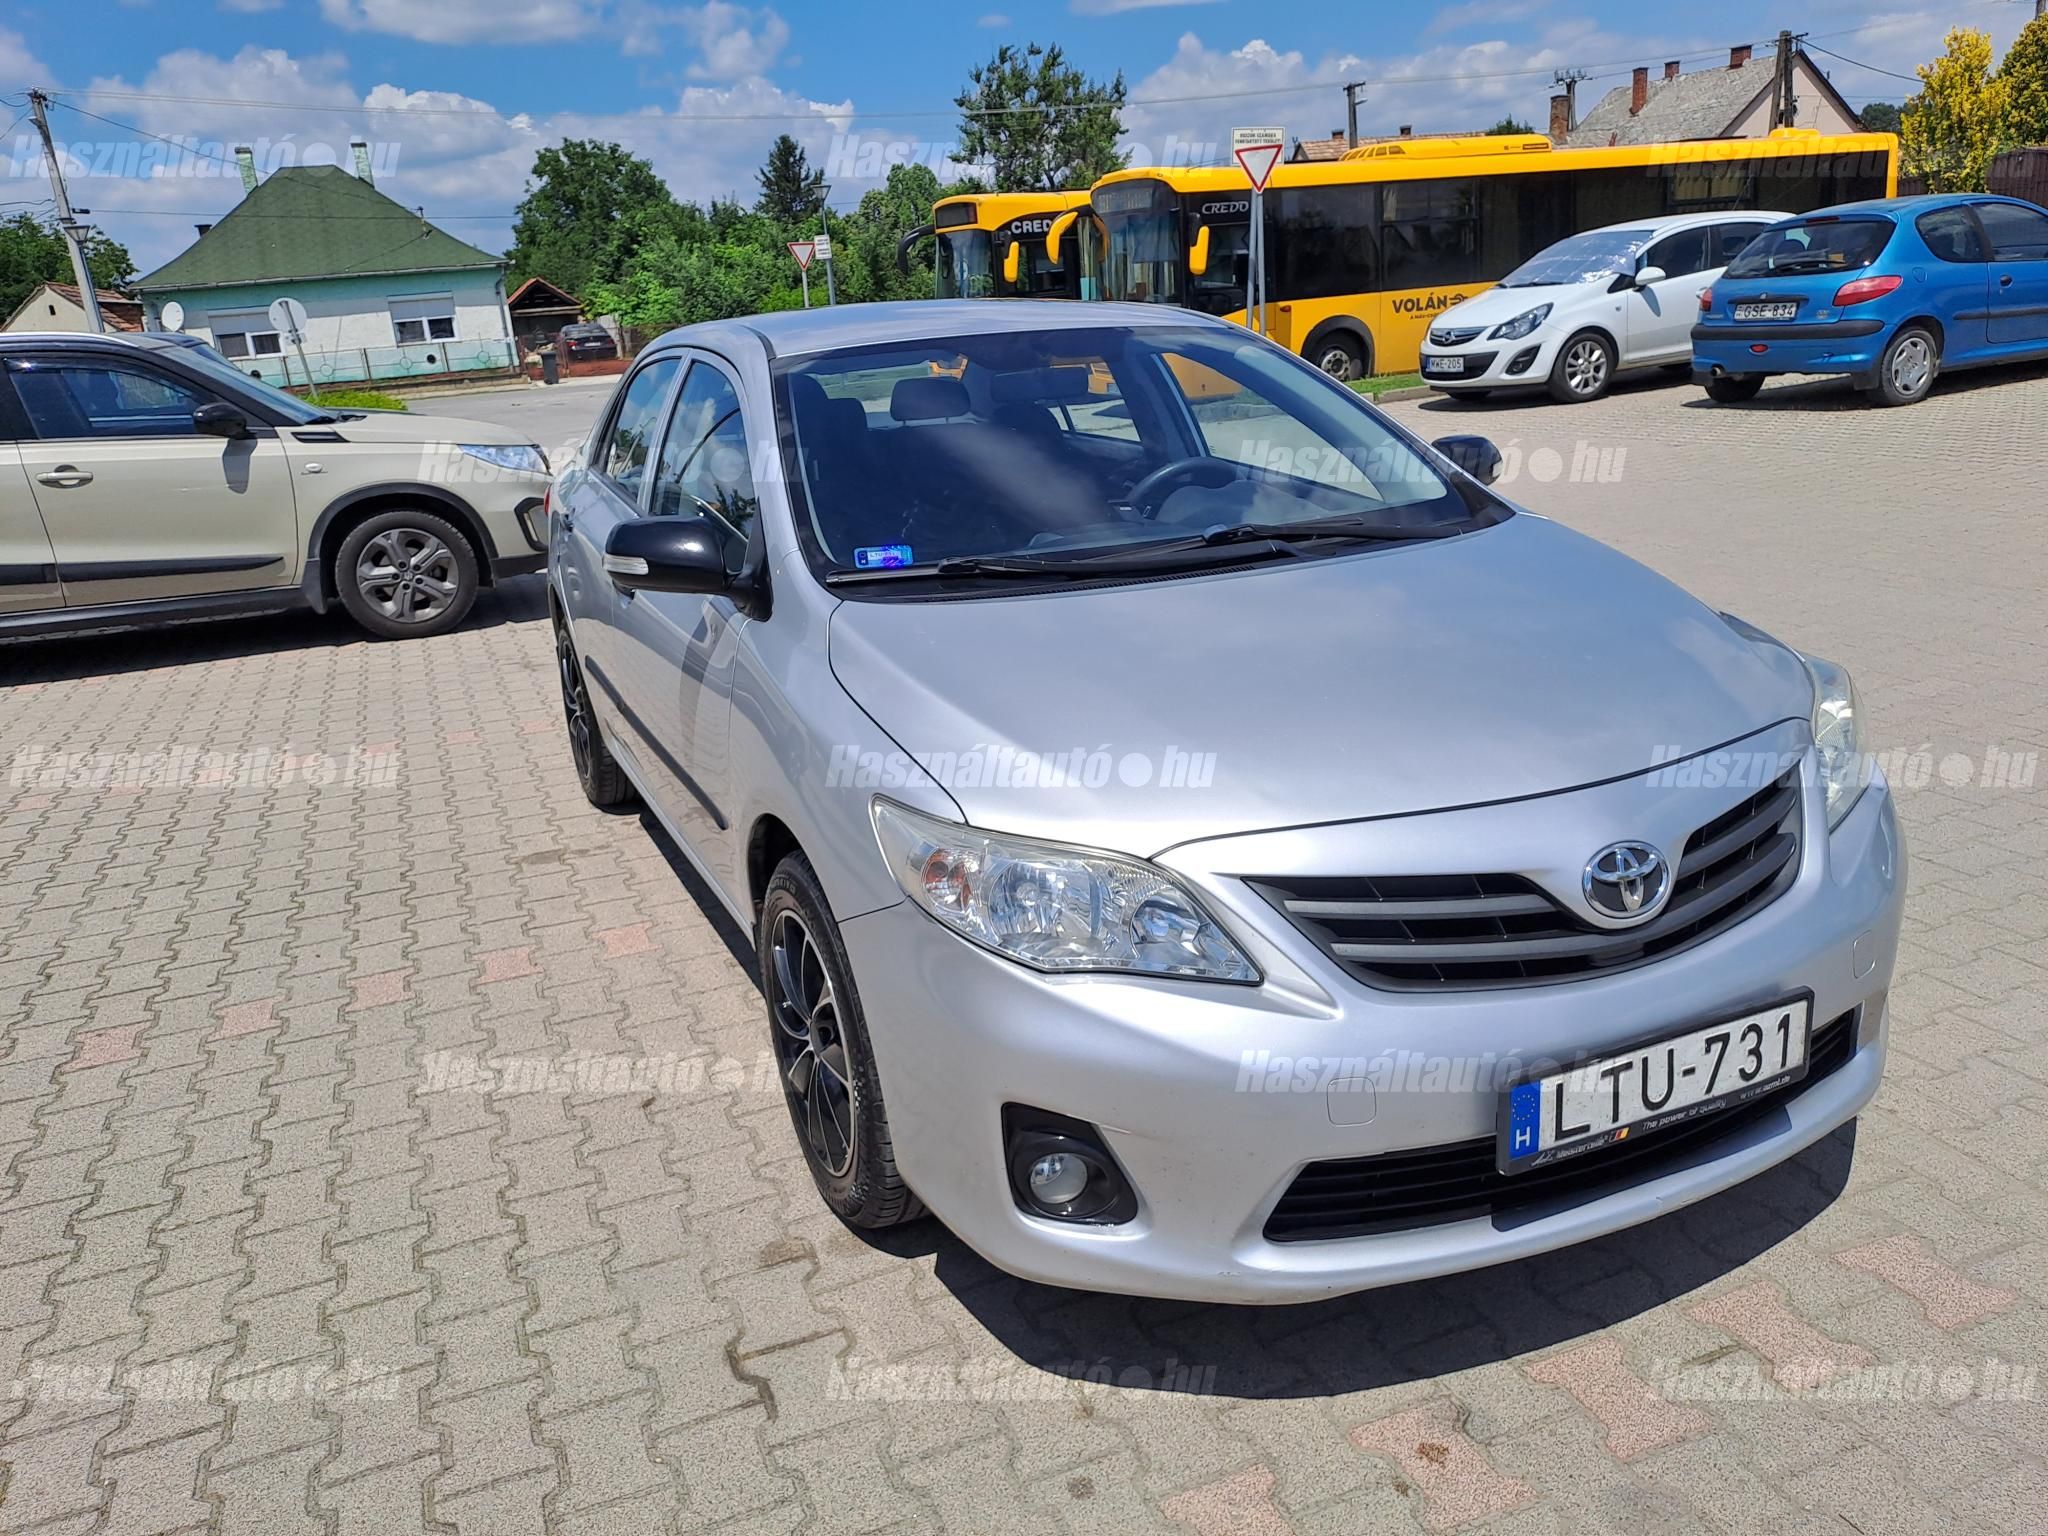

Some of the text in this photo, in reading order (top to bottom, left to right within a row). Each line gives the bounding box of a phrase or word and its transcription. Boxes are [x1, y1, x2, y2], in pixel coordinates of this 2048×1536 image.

[1202, 201, 1249, 215] CREDO
[1011, 219, 1052, 234] CRED
[1392, 292, 1448, 314] VOLÁN
[1744, 304, 1794, 318] GSE-834
[1431, 359, 1462, 369] MWE-205
[1555, 1012, 1791, 1142] LTU-731
